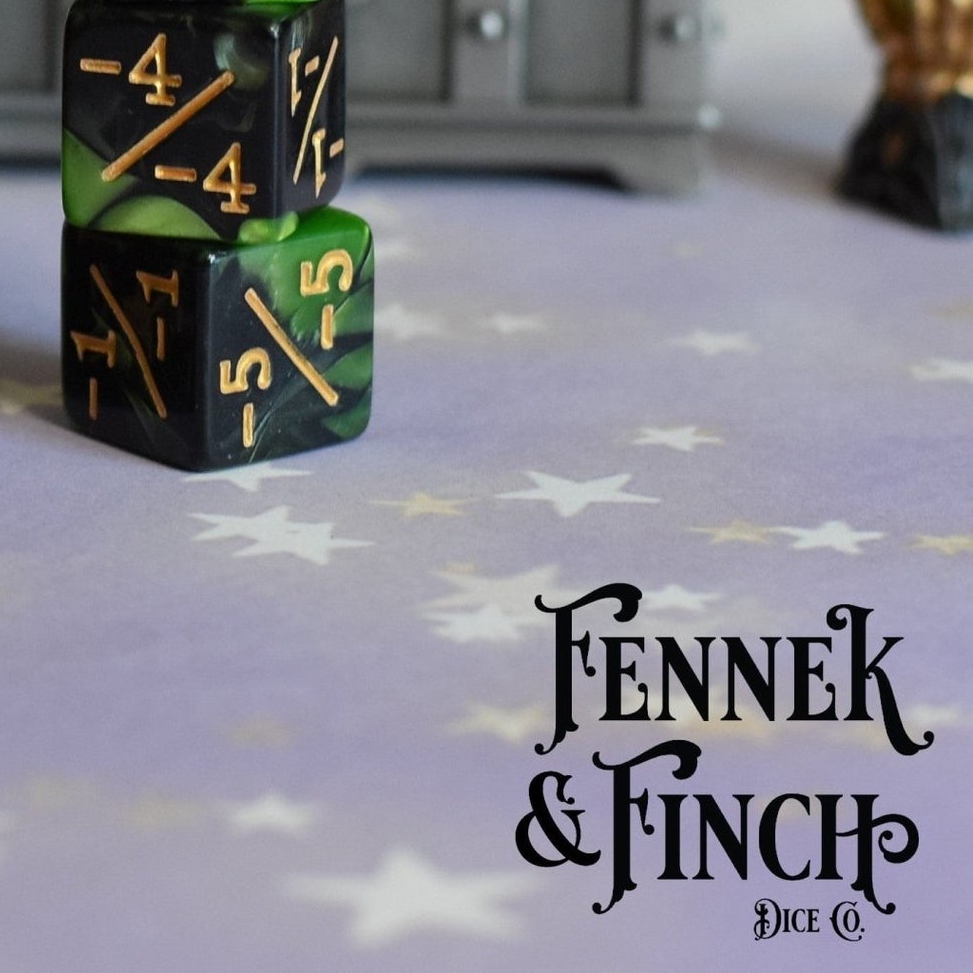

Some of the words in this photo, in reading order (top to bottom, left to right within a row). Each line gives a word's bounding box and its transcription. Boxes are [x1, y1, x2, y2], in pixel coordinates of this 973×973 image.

[79, 32, 182, 107] -4
[154, 141, 256, 214] -4
[135, 269, 180, 361] -1
[299, 248, 353, 350] -5
[70, 329, 117, 421] -1
[219, 347, 272, 449] -5
